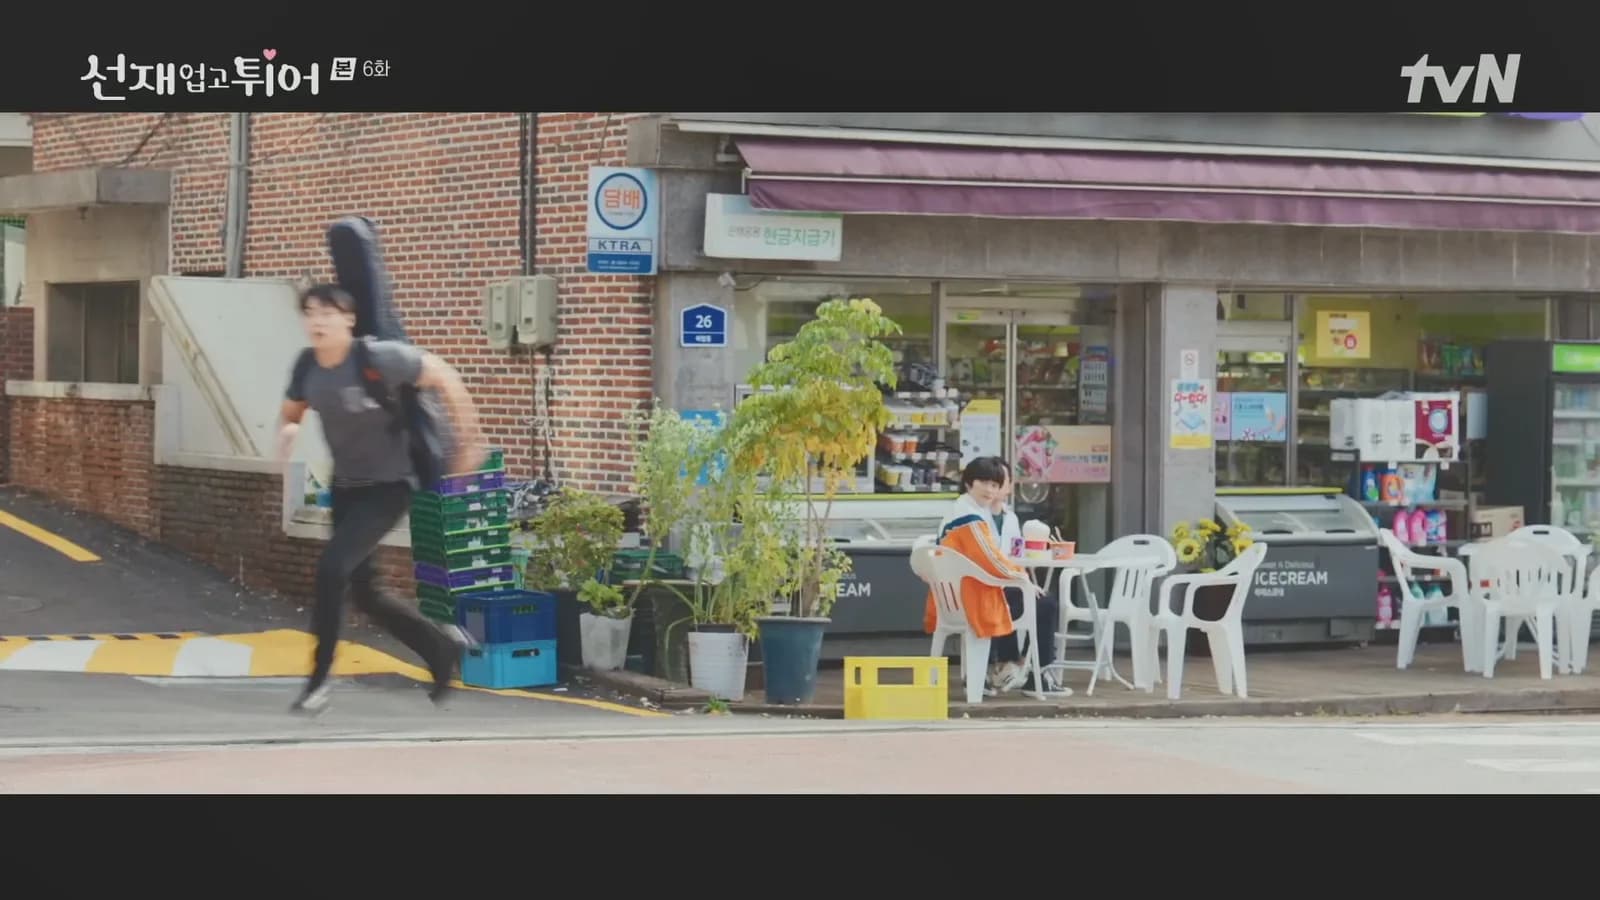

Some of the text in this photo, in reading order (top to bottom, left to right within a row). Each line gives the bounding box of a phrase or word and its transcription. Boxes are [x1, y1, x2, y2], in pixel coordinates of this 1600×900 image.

[604, 189, 640, 209] 담배
[763, 227, 836, 248] 현금지급기
[597, 240, 641, 251] KTRA
[695, 314, 712, 328] 26
[1255, 571, 1328, 585] ICECREAM
